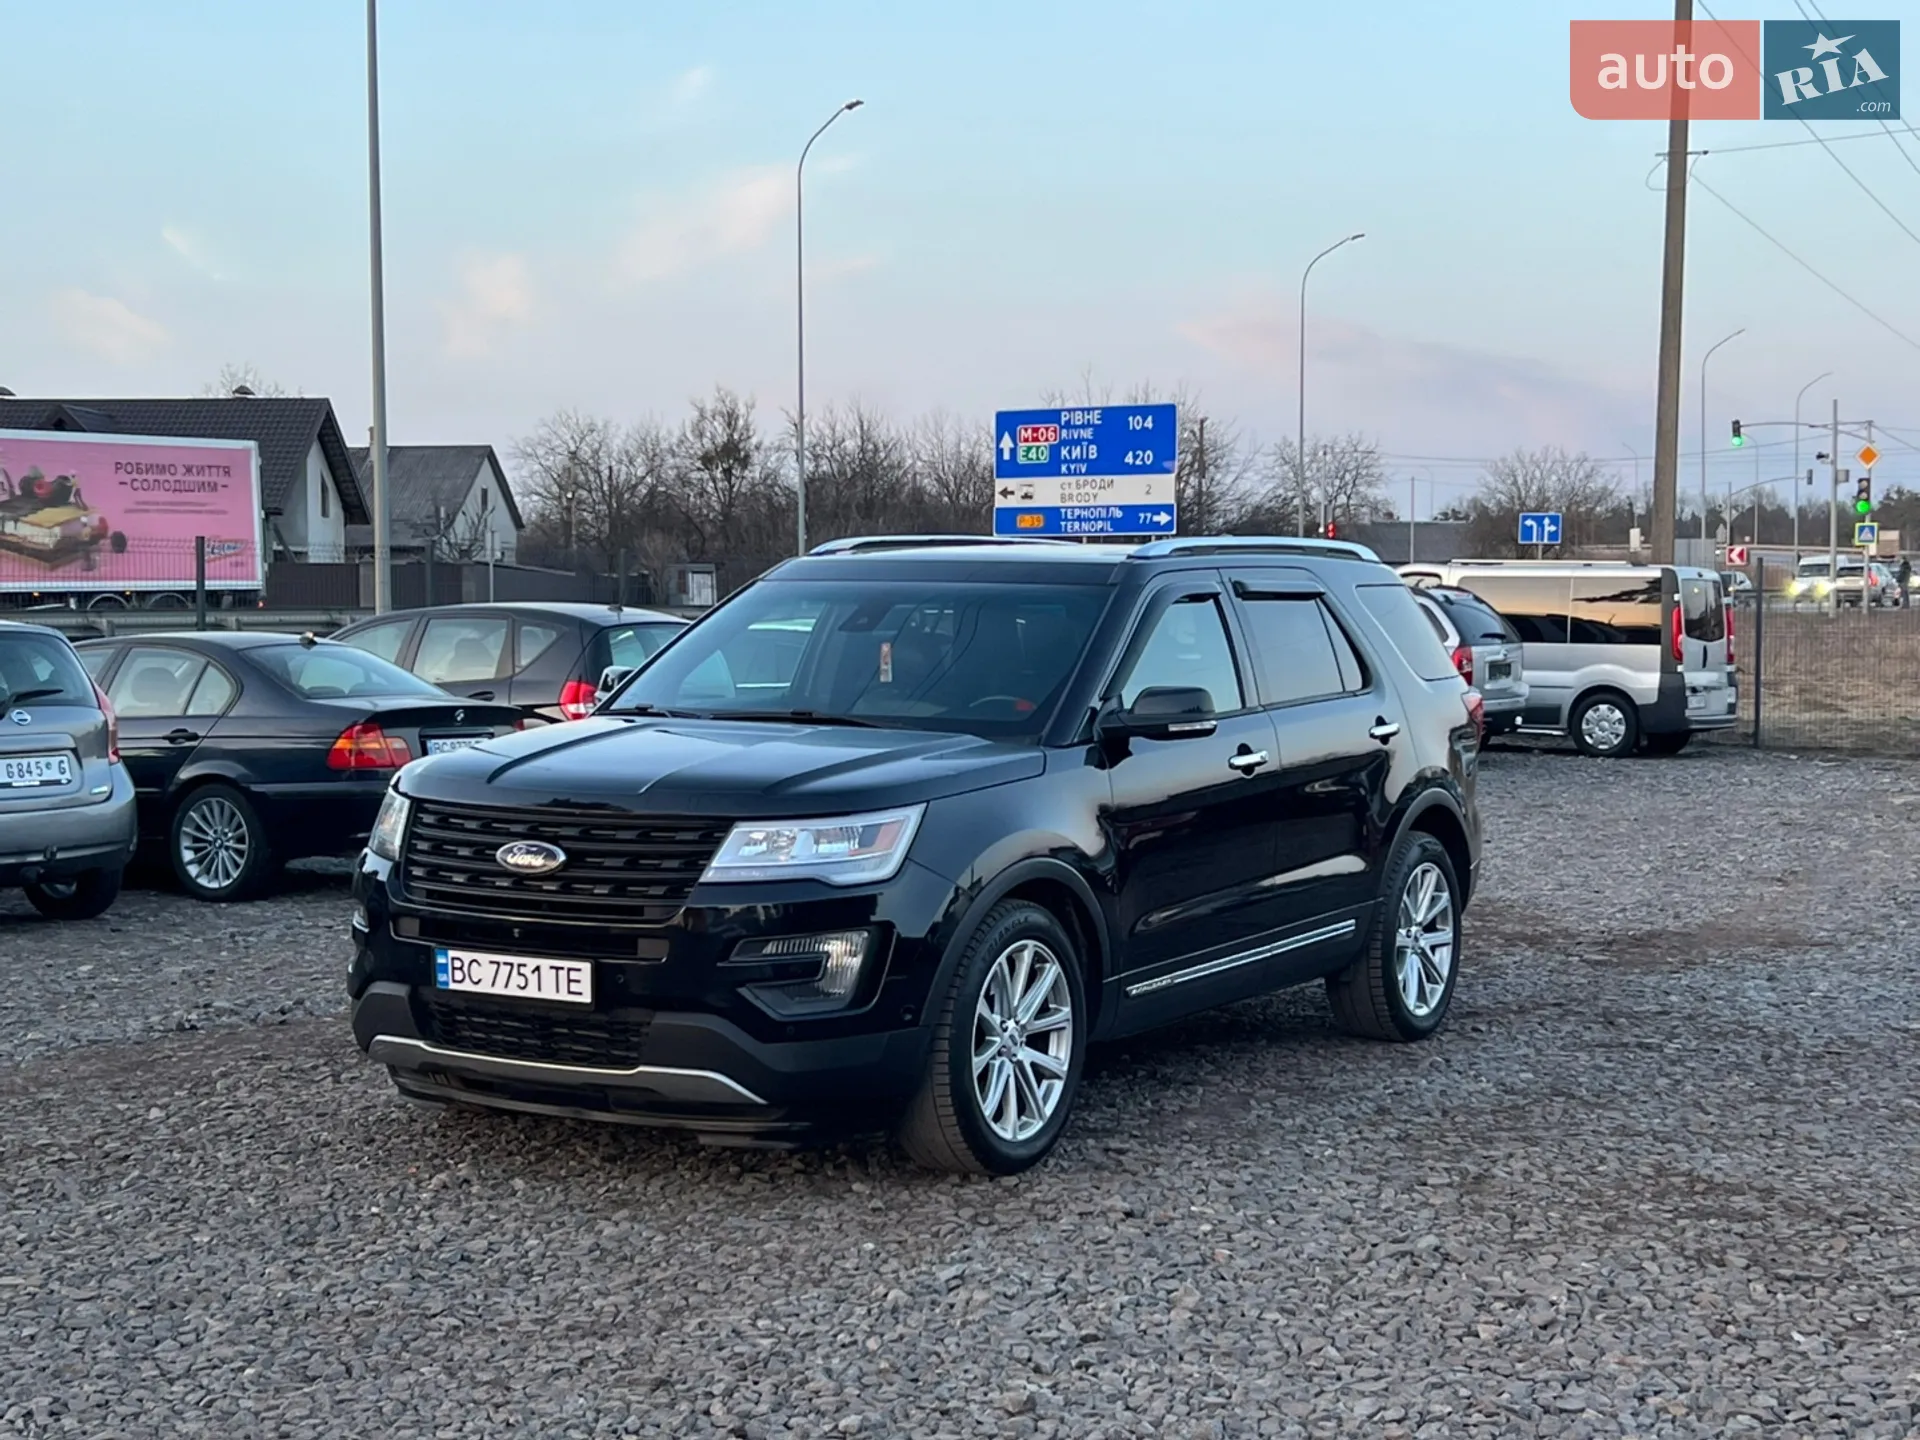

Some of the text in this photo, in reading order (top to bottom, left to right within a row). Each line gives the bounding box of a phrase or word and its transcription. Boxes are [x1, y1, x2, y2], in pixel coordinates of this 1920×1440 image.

[1060, 410, 1102, 425] РІВНЕ
[1128, 415, 1153, 431] 104
[1060, 428, 1094, 440] RIVNE
[1019, 446, 1047, 461] E40
[1060, 442, 1098, 460] КИЇВ
[1124, 450, 1153, 466] 420
[114, 462, 232, 478] РОБИМО ЖИТТЯ
[1060, 463, 1087, 474] KYIV
[1145, 484, 1152, 495] 2
[1060, 492, 1099, 503] BRODY
[1060, 507, 1123, 519] ТЕРНОПІЛЬ
[1138, 513, 1151, 525] 77
[1060, 520, 1114, 532] TERNOPIL
[5, 760, 44, 779] 6845
[506, 844, 547, 866] Ford
[450, 956, 583, 996] BC 7751 TE
